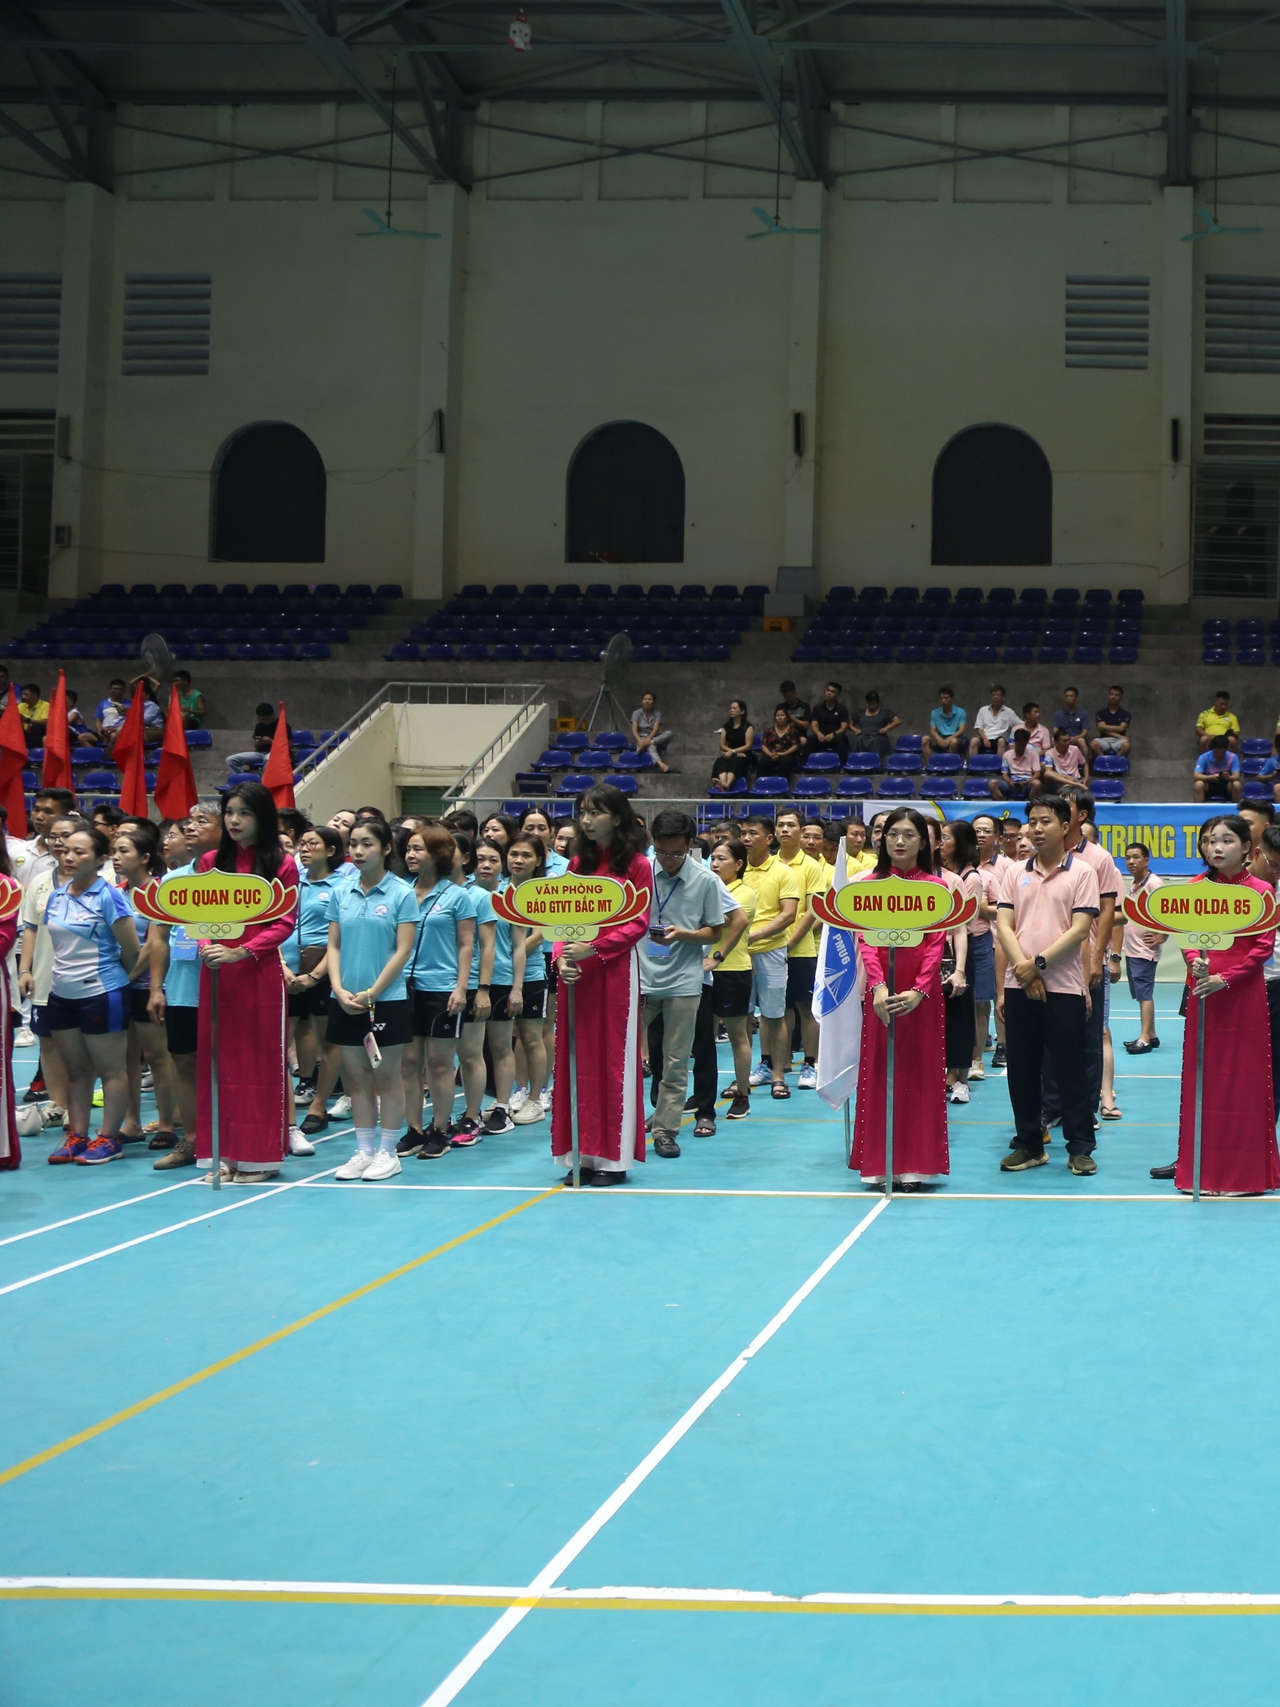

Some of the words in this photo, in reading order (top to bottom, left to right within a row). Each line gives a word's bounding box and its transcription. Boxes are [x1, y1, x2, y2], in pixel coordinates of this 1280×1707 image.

[535, 883, 559, 895] VĂN
[562, 882, 603, 895] PHÒNG
[169, 888, 188, 906] CƠ
[192, 889, 229, 907] QUAN
[233, 888, 262, 909] CỤC
[526, 898, 545, 914] BÁO
[549, 900, 573, 913] GTVT
[575, 895, 595, 913] BẮC
[598, 899, 613, 913] MT
[853, 895, 882, 912] BAN
[887, 895, 923, 913] QLDA
[927, 895, 936, 912] 6
[1160, 898, 1190, 914] BAN
[1194, 898, 1229, 916] QLDA
[1233, 899, 1251, 915] 85
[832, 933, 851, 966] PMU6
